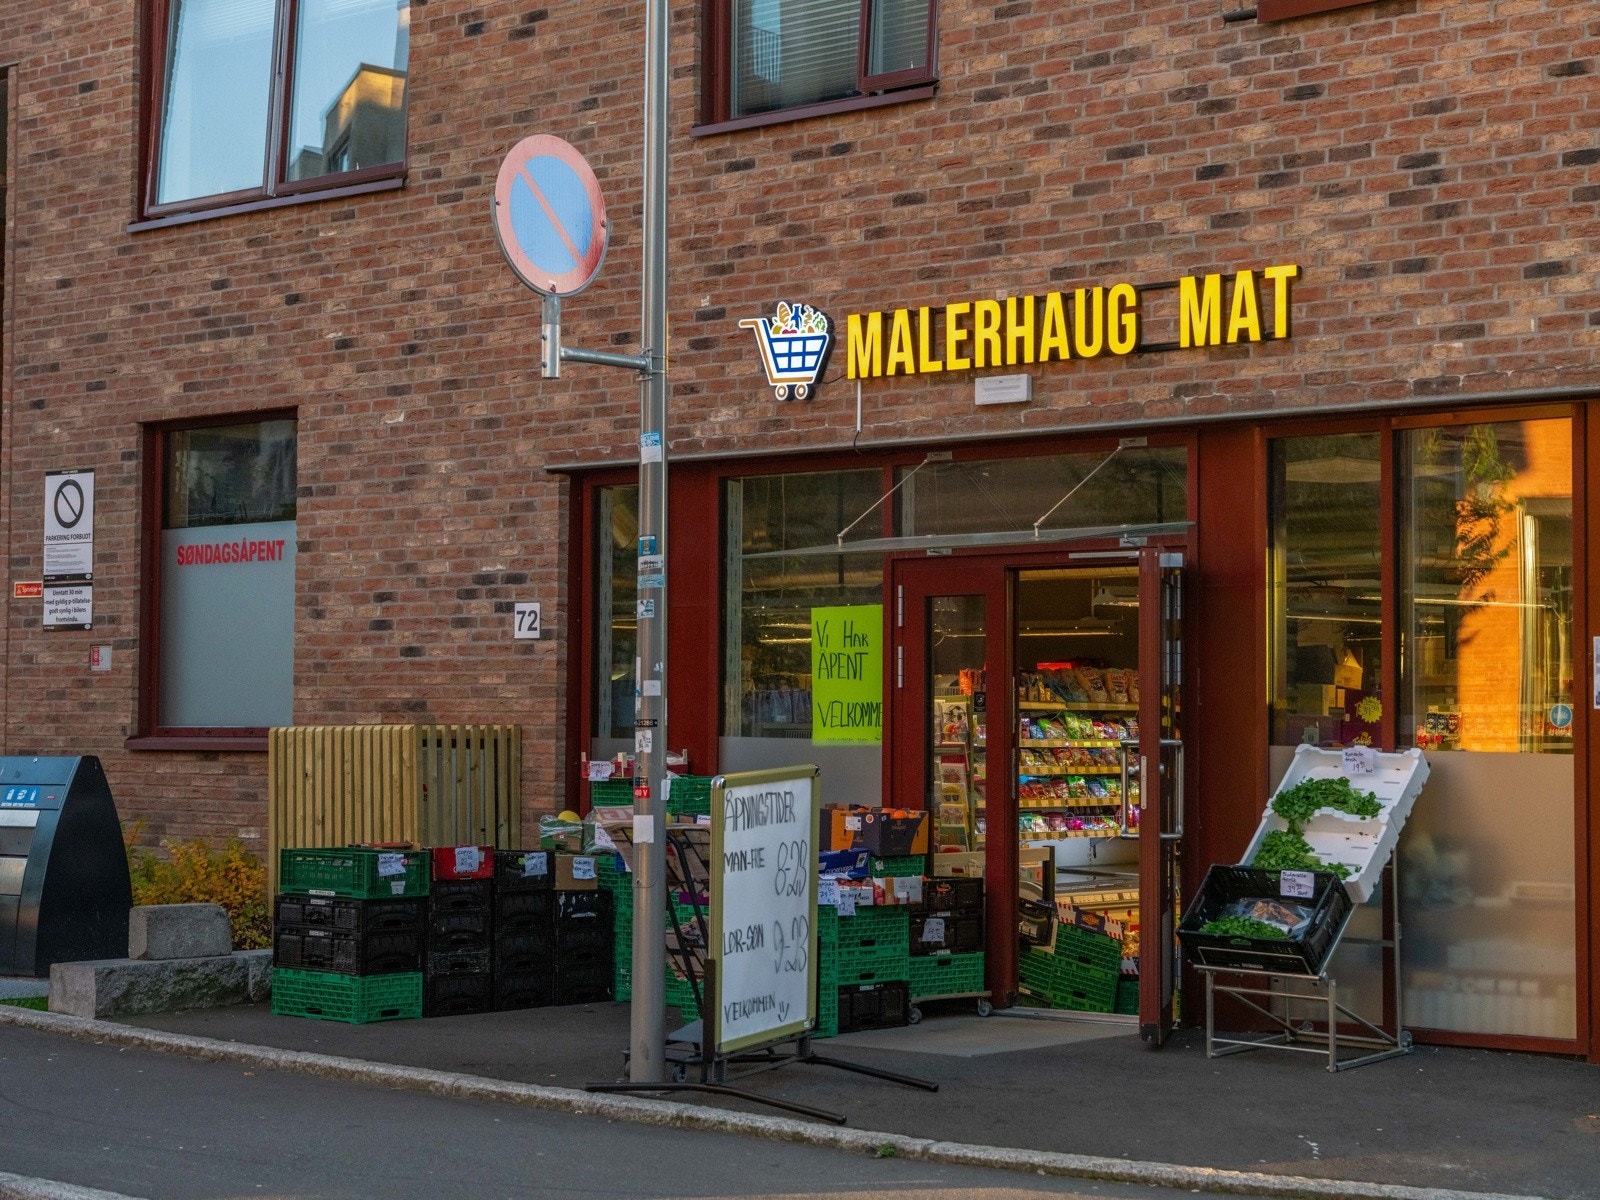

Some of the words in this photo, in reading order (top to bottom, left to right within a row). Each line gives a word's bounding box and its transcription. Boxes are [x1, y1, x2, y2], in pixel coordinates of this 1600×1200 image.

[847, 283, 1137, 380] MALERHAUG
[1179, 264, 1298, 348] MAT
[177, 537, 285, 566] SØNDAGSÅPENT
[516, 610, 538, 631] 72
[818, 650, 869, 681] ÅPENT
[724, 789, 796, 832] ÅPNINGSTIDER
[723, 992, 777, 1023] VELKOMMEN
